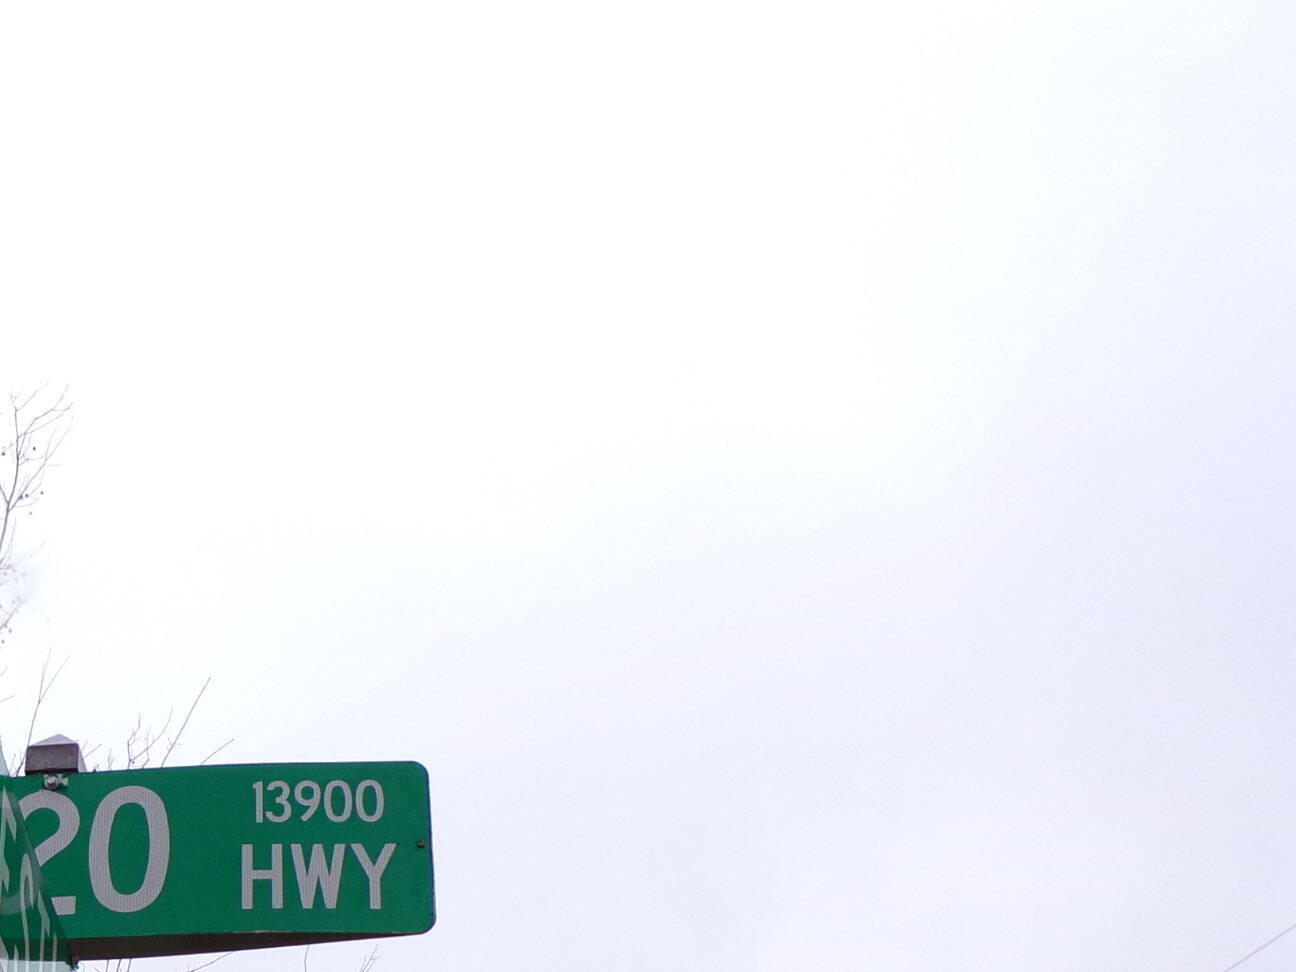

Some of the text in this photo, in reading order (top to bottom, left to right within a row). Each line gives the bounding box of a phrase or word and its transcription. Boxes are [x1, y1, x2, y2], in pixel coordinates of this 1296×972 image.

[252, 779, 385, 825] 13900
[17, 785, 171, 916] 20
[241, 843, 398, 910] HWY
